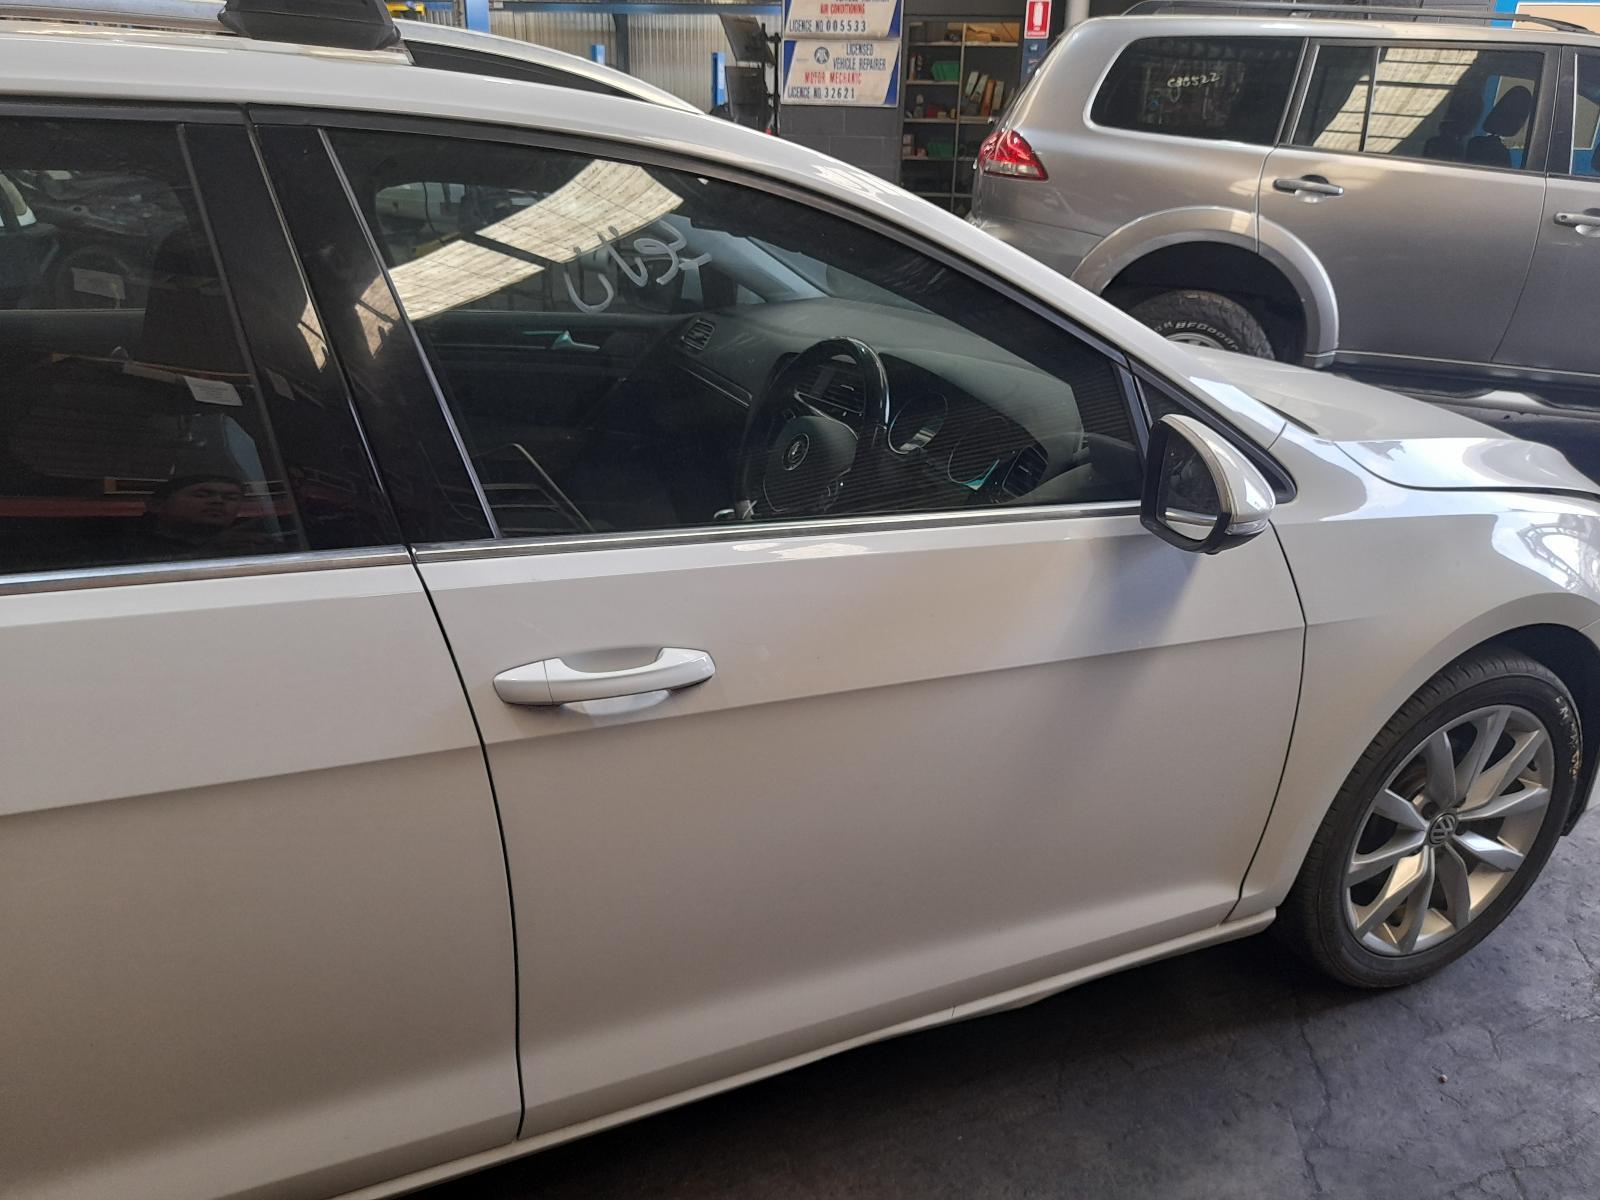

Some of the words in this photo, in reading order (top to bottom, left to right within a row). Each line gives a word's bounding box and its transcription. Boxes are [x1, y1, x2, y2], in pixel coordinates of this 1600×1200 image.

[831, 3, 865, 14] CONDITIONING
[789, 20, 812, 33] LICENCE
[826, 20, 866, 33] 005533
[846, 43, 874, 56] LICENSED
[833, 57, 856, 70] VEHICLE
[859, 58, 887, 71] REPAIRER
[805, 71, 825, 84] MOTOR
[830, 71, 862, 84] MECHANIC
[787, 87, 810, 99] LICENCE
[824, 87, 854, 99] 32621
